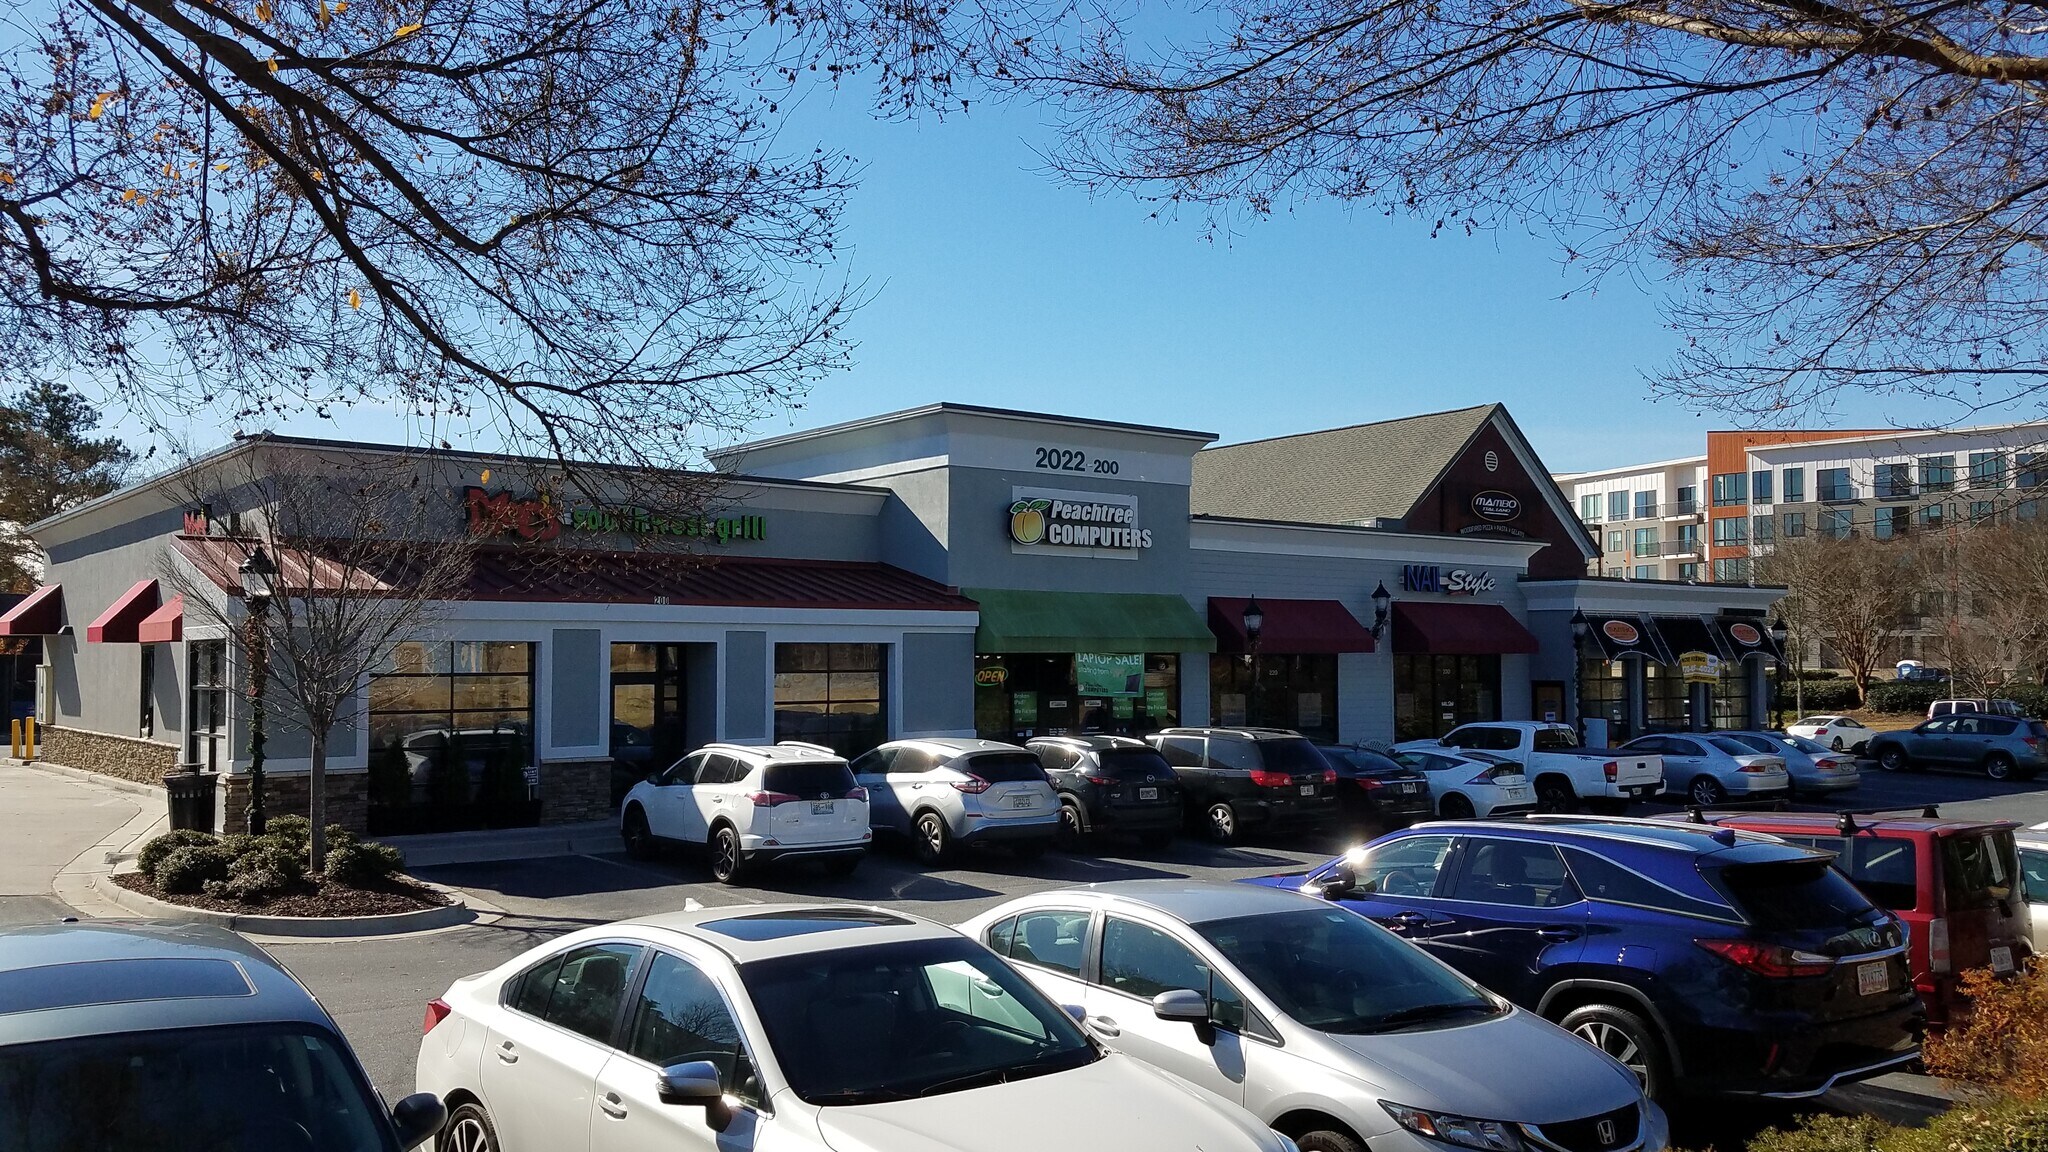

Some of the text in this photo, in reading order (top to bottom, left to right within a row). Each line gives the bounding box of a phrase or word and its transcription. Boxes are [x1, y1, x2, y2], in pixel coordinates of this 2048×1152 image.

[1035, 447, 1085, 471] 2022
[1051, 500, 1134, 524] Peachtree
[1475, 497, 1517, 509] MAMBO
[716, 515, 766, 544] grill
[1049, 523, 1153, 549] COMPUTERS
[1448, 569, 1497, 596] Style
[1115, 654, 1142, 665] SALE!
[977, 670, 1005, 683] OPEN
